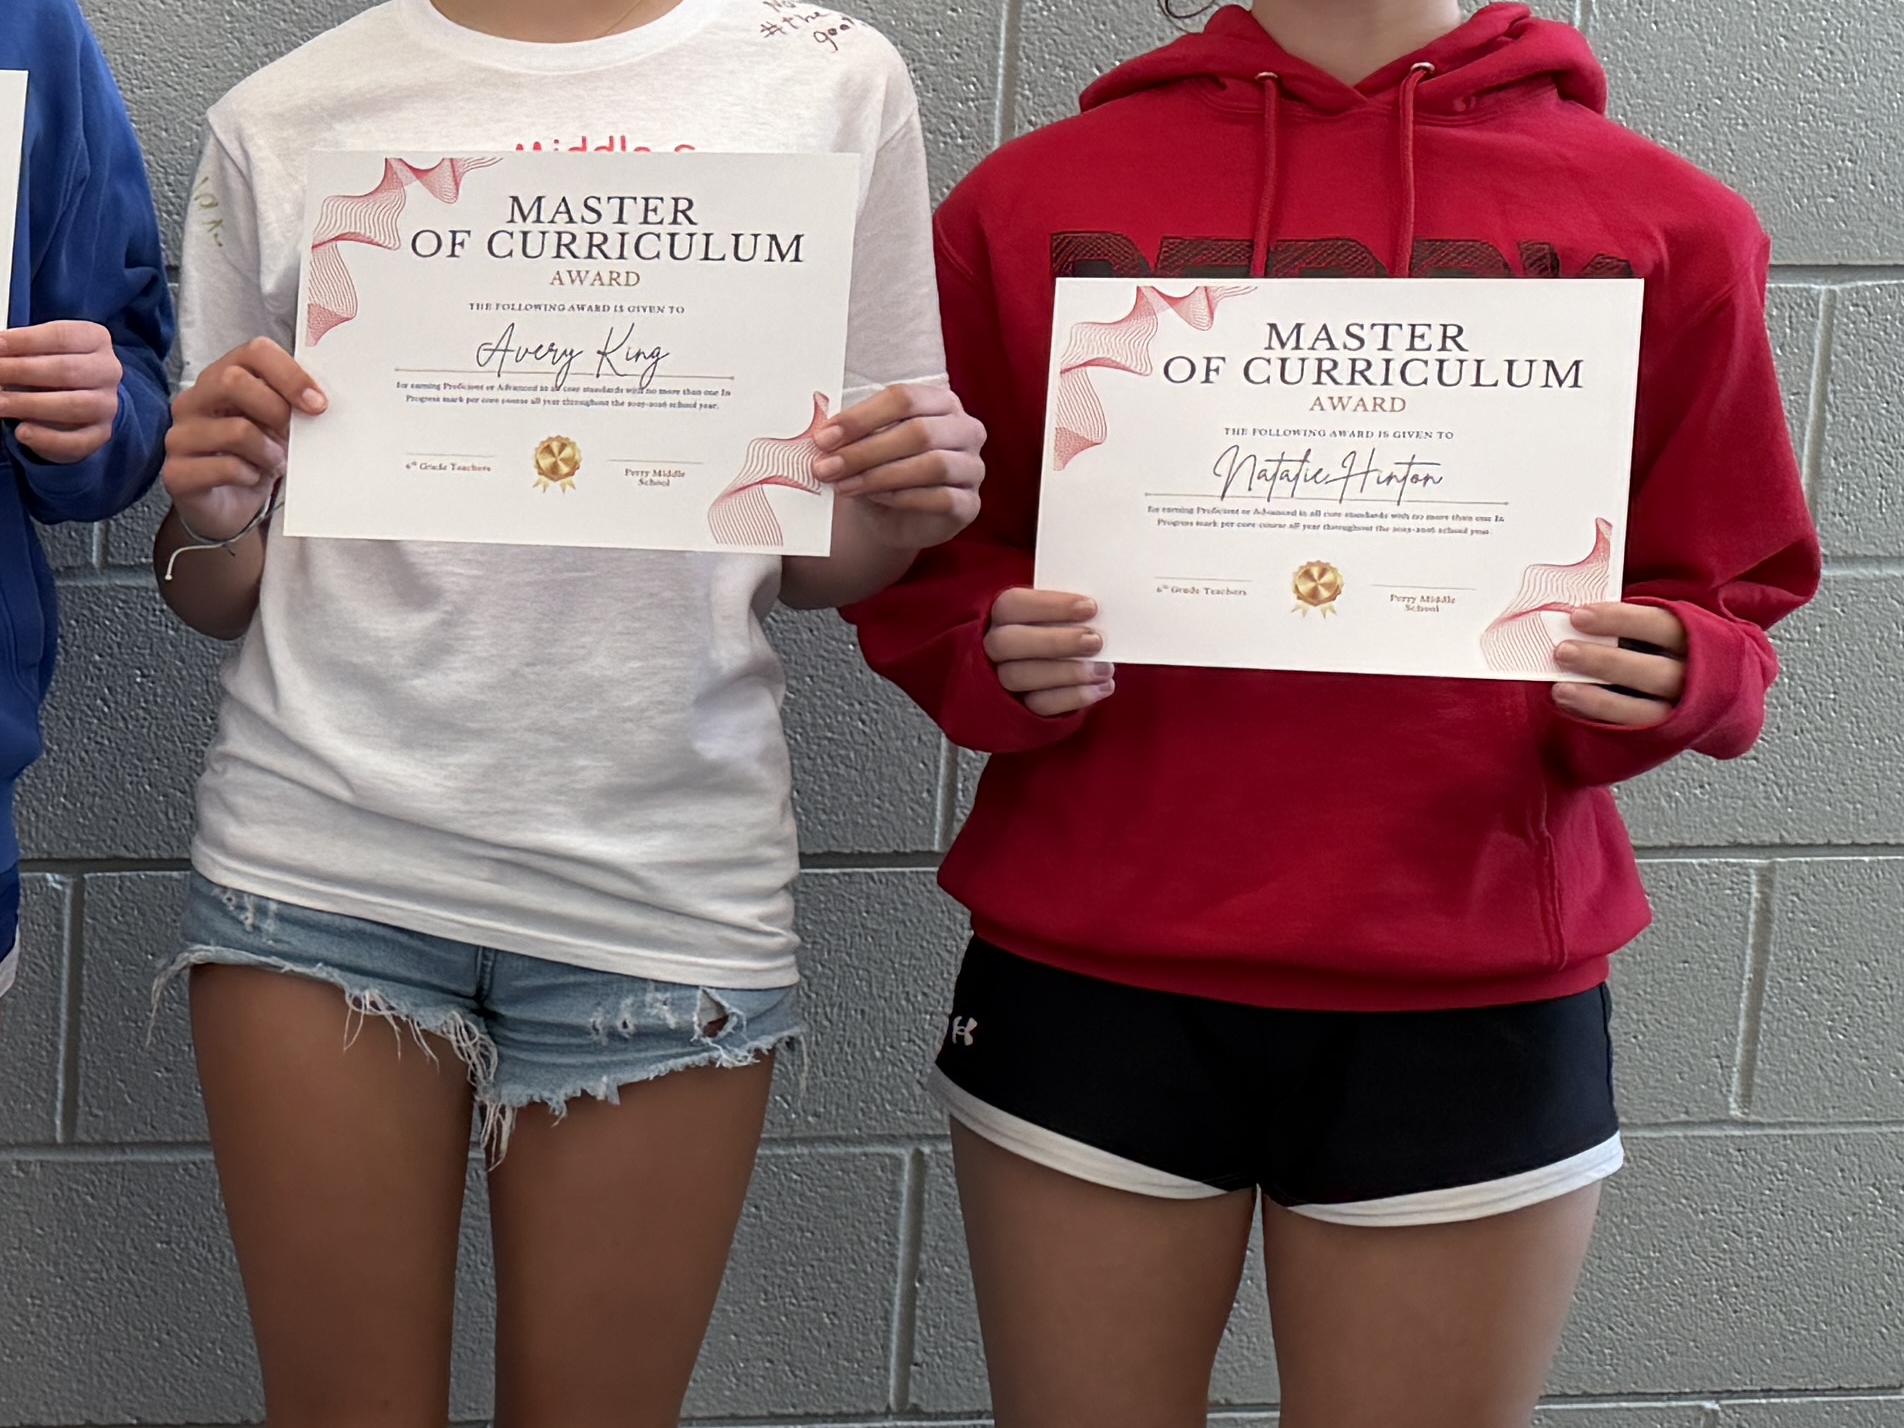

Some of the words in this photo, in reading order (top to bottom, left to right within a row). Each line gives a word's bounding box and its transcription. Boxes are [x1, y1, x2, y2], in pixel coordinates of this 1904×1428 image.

[506, 196, 697, 225] MASTER
[411, 229, 470, 257] OF
[487, 230, 804, 262] CURRICULUM
[550, 270, 640, 286] AWARD
[468, 302, 492, 311] THE
[566, 303, 611, 312] AWARD
[613, 304, 624, 313] IS
[626, 304, 665, 314] GIVEN
[667, 305, 685, 314] TO
[1264, 323, 1468, 351] MASTER
[473, 322, 584, 389] Avery
[595, 322, 670, 389] King
[1163, 356, 1225, 383] OF
[1243, 357, 1583, 388] CURRICULUM
[1309, 396, 1405, 412] AWARD
[1224, 426, 1248, 436] THE
[1328, 429, 1374, 439] AWARD
[1377, 429, 1389, 438] IS
[1392, 430, 1433, 440] GIVEN
[1435, 430, 1454, 440] TO
[1212, 444, 1326, 503] Natalie
[1324, 447, 1443, 506] Hinton
